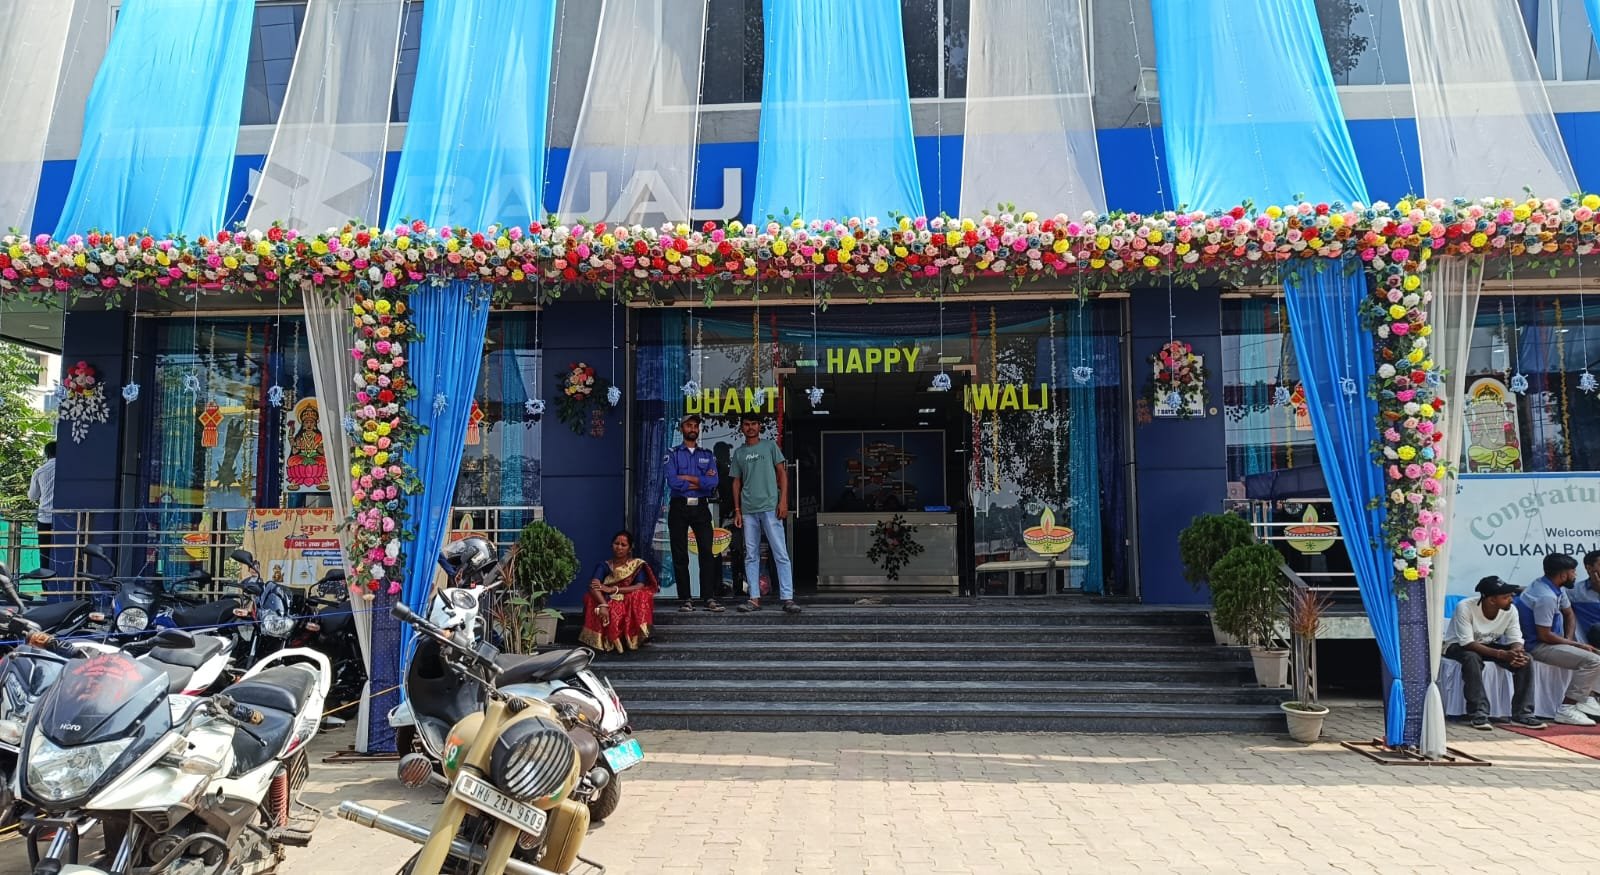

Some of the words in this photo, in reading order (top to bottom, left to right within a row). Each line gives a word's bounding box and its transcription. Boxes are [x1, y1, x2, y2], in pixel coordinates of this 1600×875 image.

[408, 168, 741, 222] BAJAJ
[827, 348, 920, 373] HAPPY
[1545, 527, 1600, 537] Welcome
[1483, 543, 1556, 556] VOLKAN
